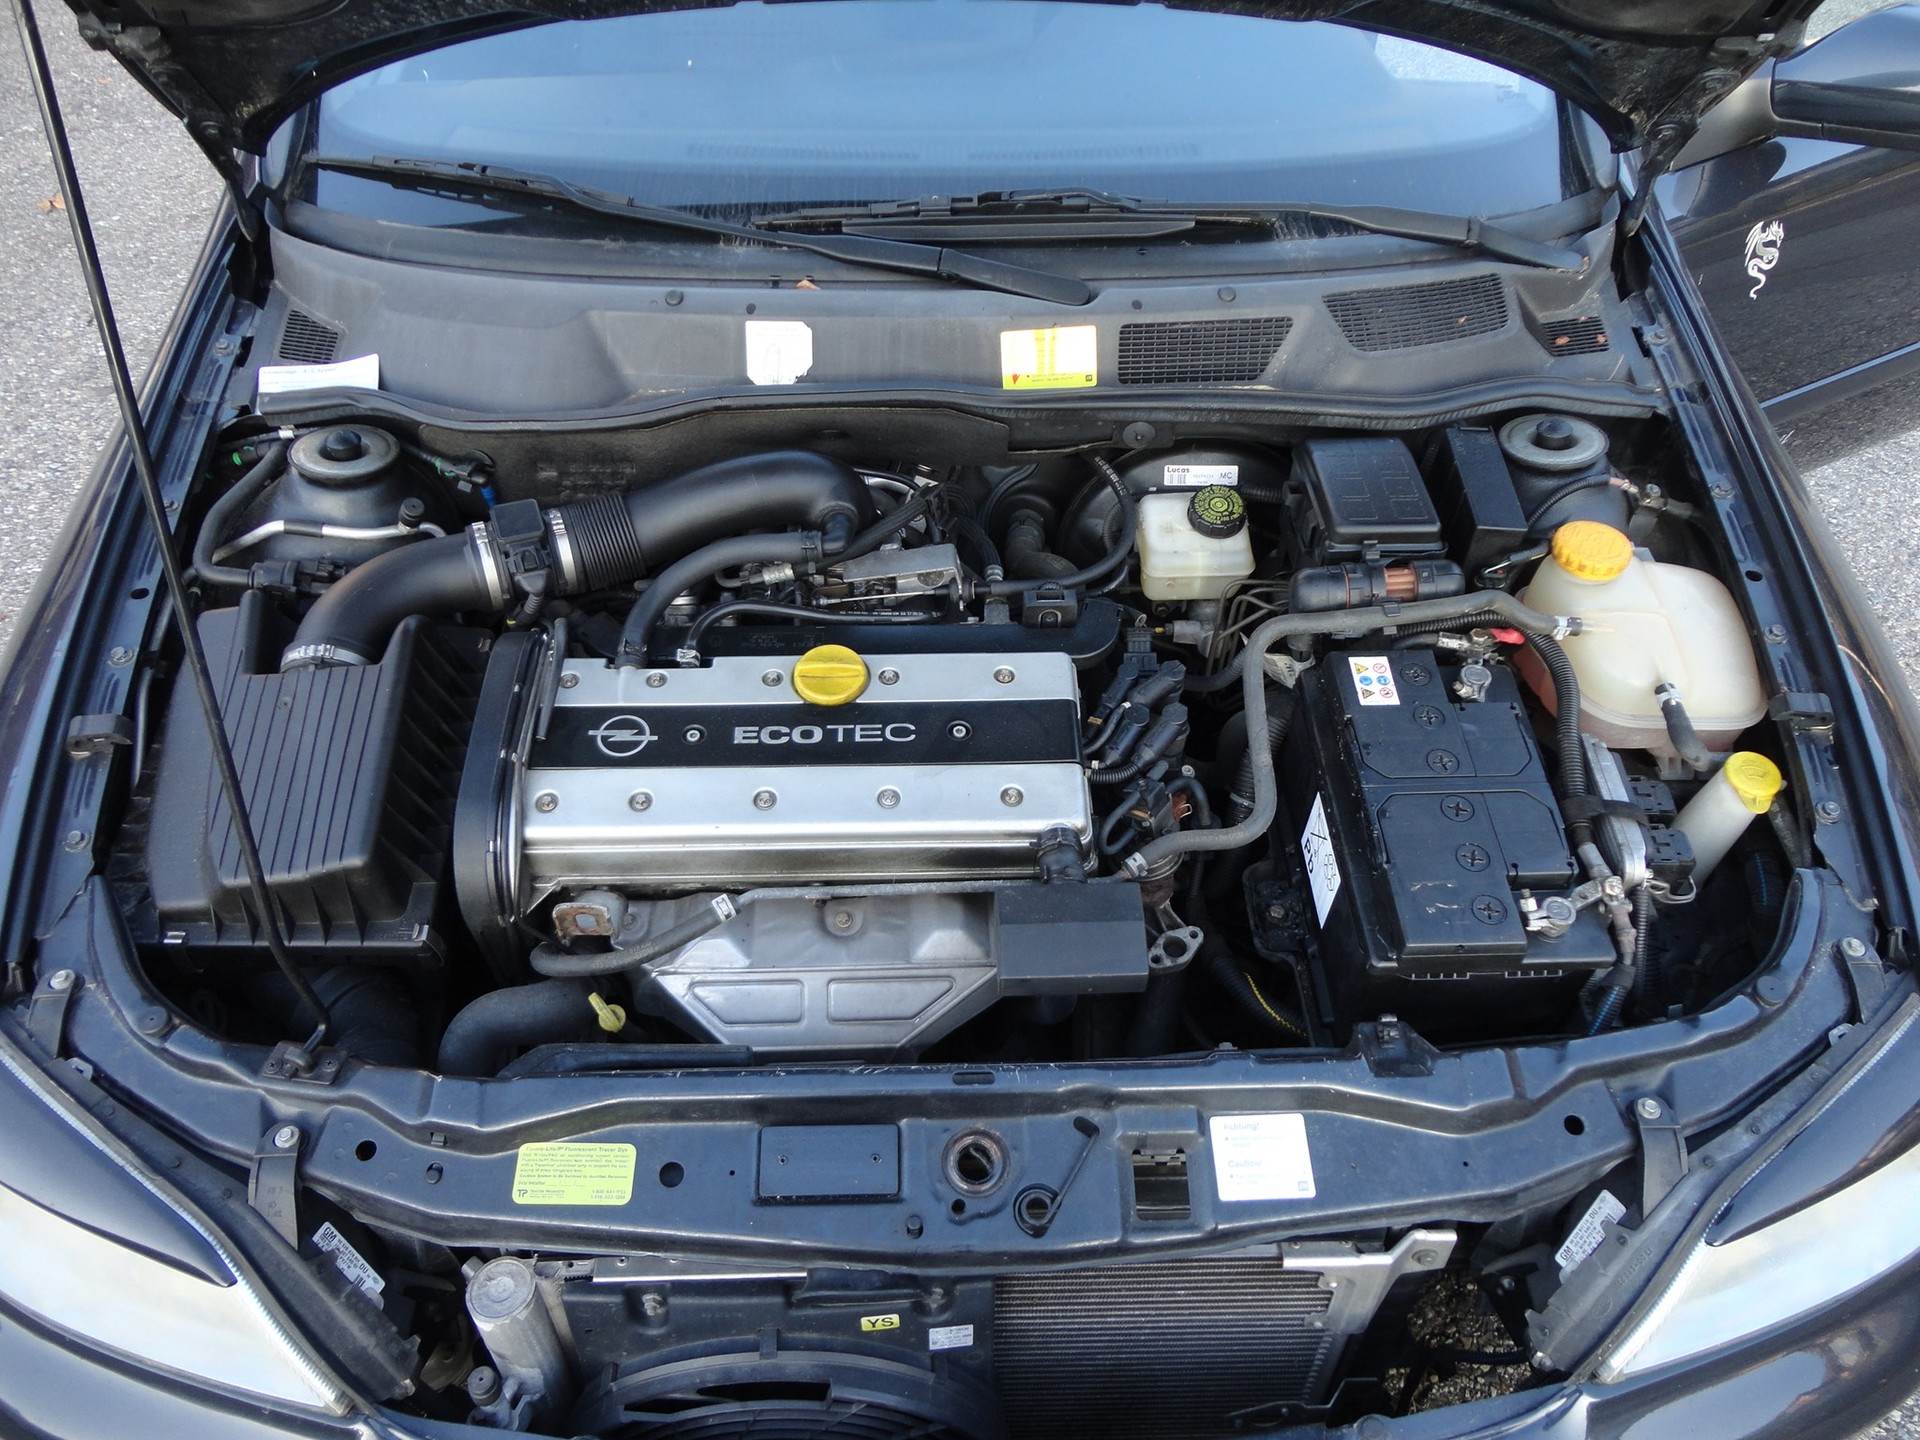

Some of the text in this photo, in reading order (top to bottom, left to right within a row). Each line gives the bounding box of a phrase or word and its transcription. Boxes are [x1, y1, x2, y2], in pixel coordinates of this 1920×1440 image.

[734, 724, 916, 744] ECOTEC
[1223, 1122, 1259, 1131] Achtung!
[1228, 1160, 1262, 1168] Caution!
[1589, 1207, 1598, 1219] DU
[324, 1226, 337, 1242] GM
[1560, 1245, 1574, 1260] GM
[359, 1263, 369, 1274] DU
[867, 1317, 894, 1328] YS
